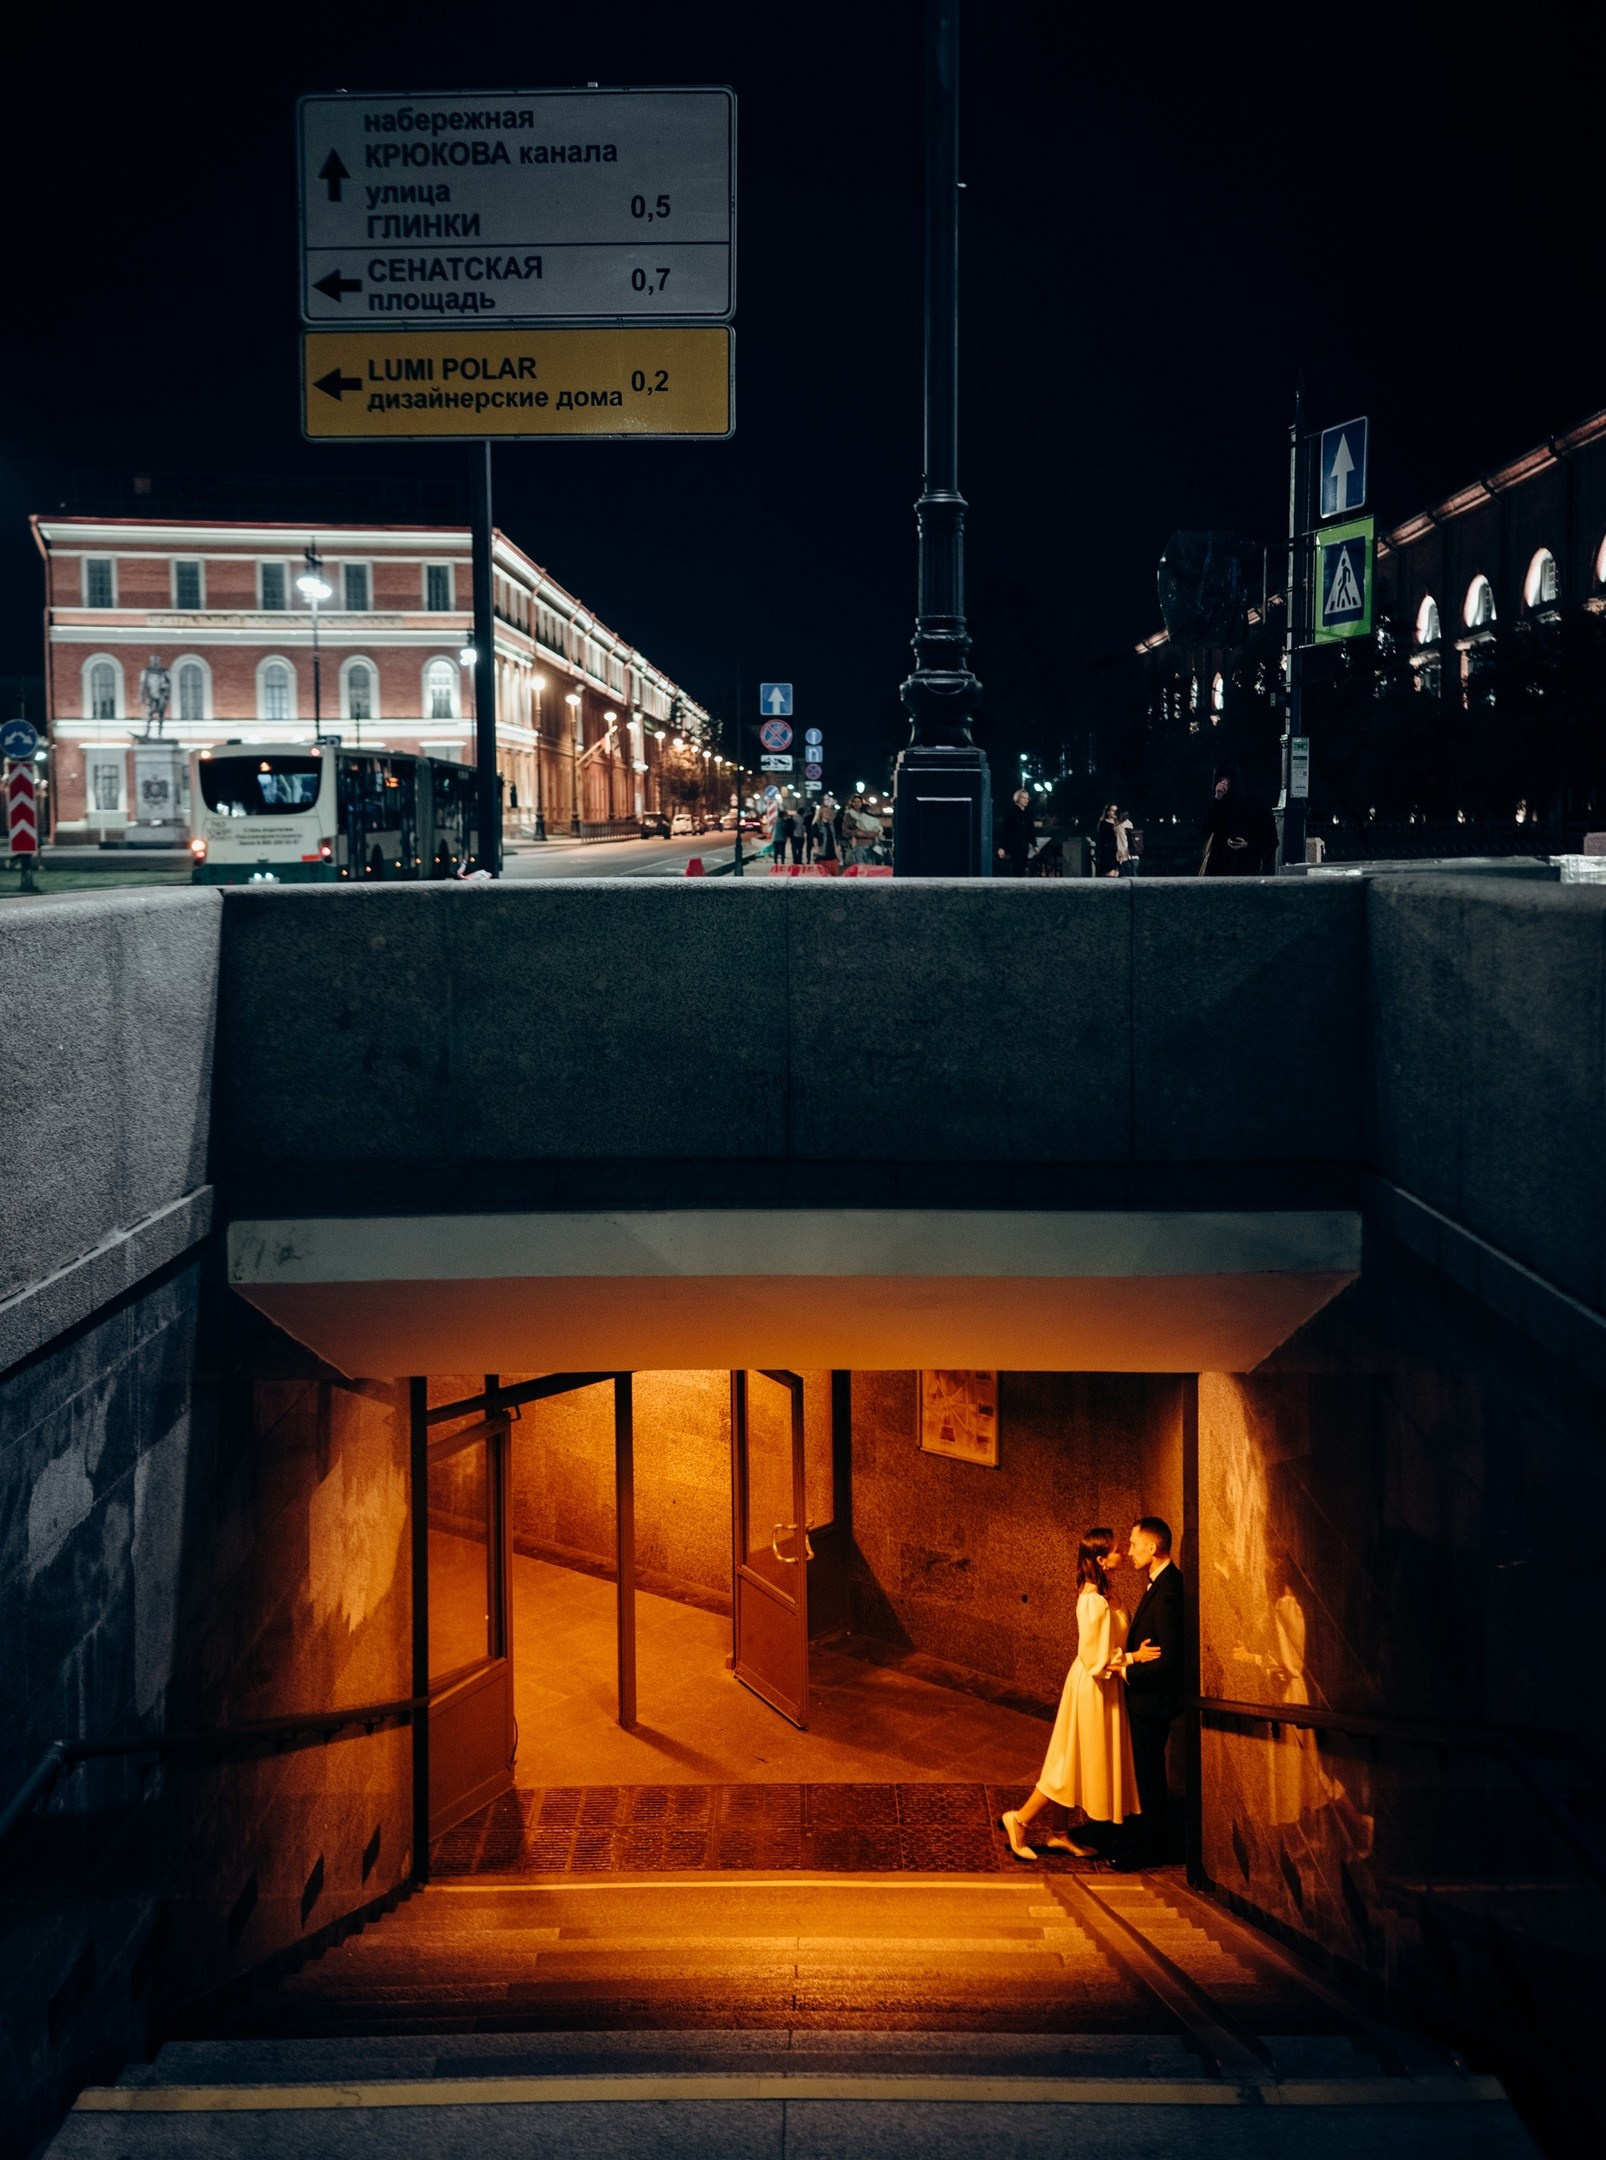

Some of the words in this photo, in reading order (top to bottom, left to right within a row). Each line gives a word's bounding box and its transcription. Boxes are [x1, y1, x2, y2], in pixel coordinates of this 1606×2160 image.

[364, 107, 534, 136] набережная
[365, 141, 511, 168] КРЮКОВА
[520, 144, 618, 164] канала
[365, 184, 451, 210] улица
[631, 195, 671, 222] 0,5
[367, 213, 481, 239] ГЛИНКИ
[368, 256, 543, 282] СЕНАТСКАЯ
[631, 268, 671, 295] 0,7
[369, 292, 496, 313] площадь
[369, 358, 434, 381] LUMI
[443, 357, 537, 380] POLAR
[631, 370, 669, 395] 0,2
[367, 387, 549, 413] дизайнерские
[556, 391, 623, 410] дома
